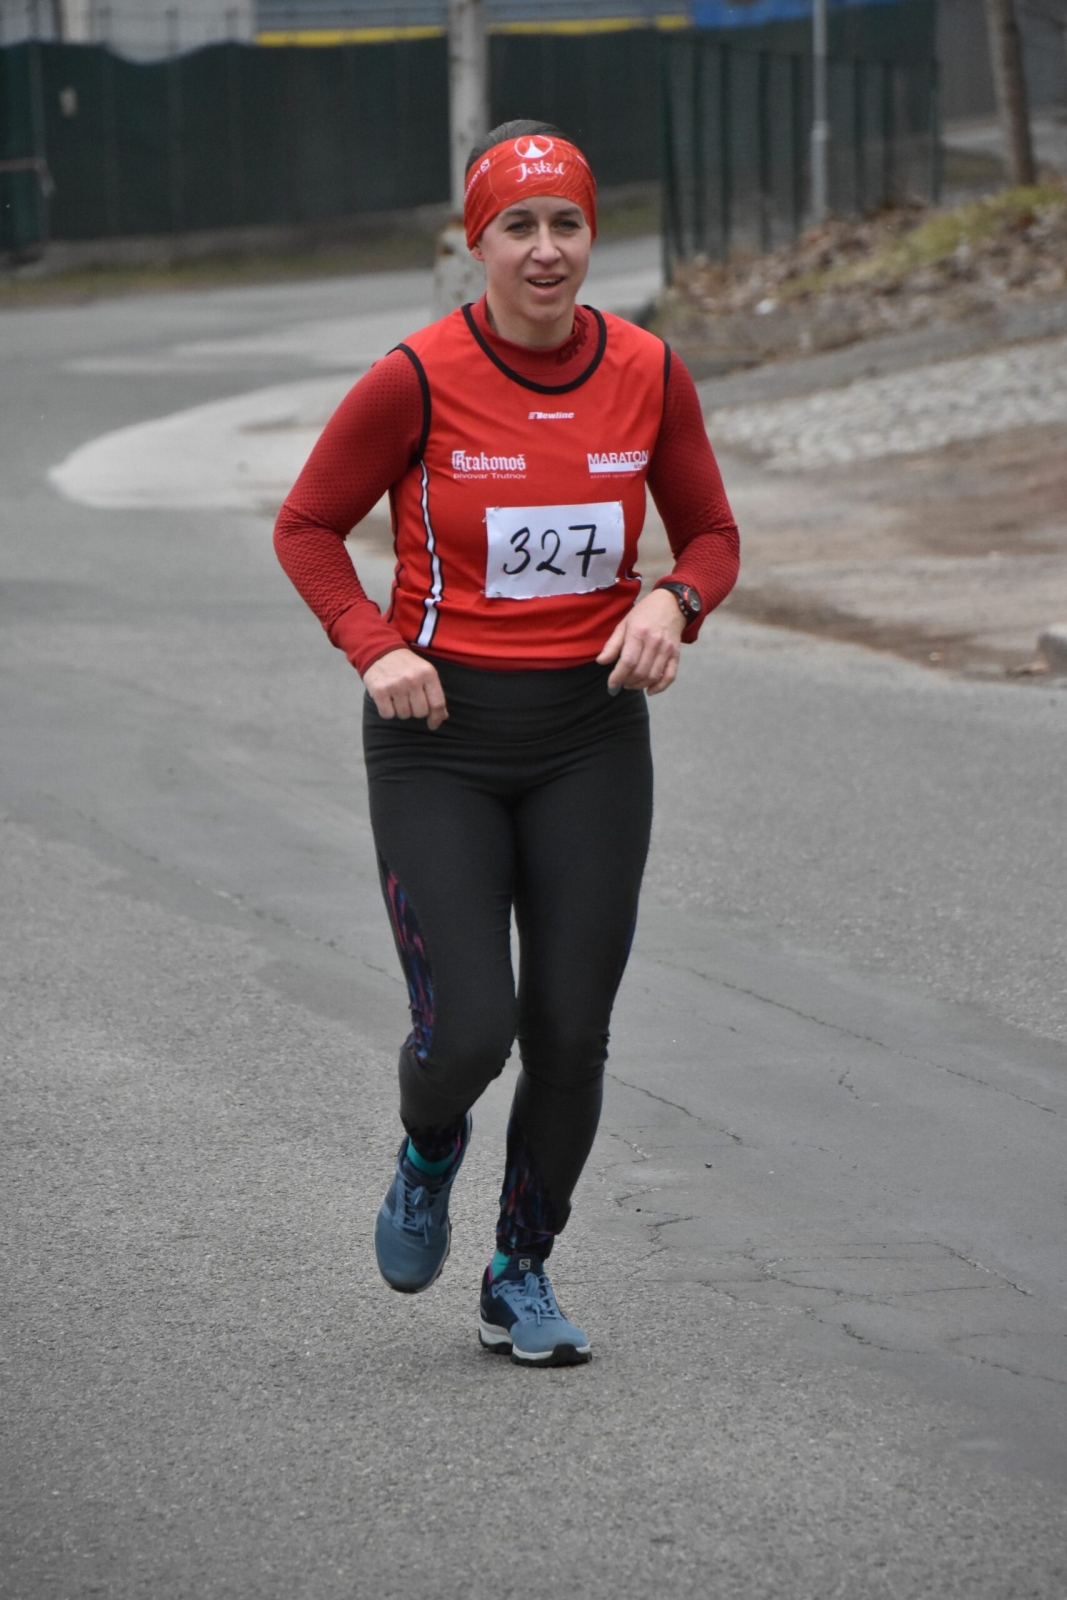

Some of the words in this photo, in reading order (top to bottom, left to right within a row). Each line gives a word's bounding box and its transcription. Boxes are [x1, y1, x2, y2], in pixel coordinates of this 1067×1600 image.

[452, 450, 526, 472] Krakonoš
[587, 450, 649, 464] MARATON
[491, 472, 526, 480] Trutnov
[503, 524, 607, 578] 327
